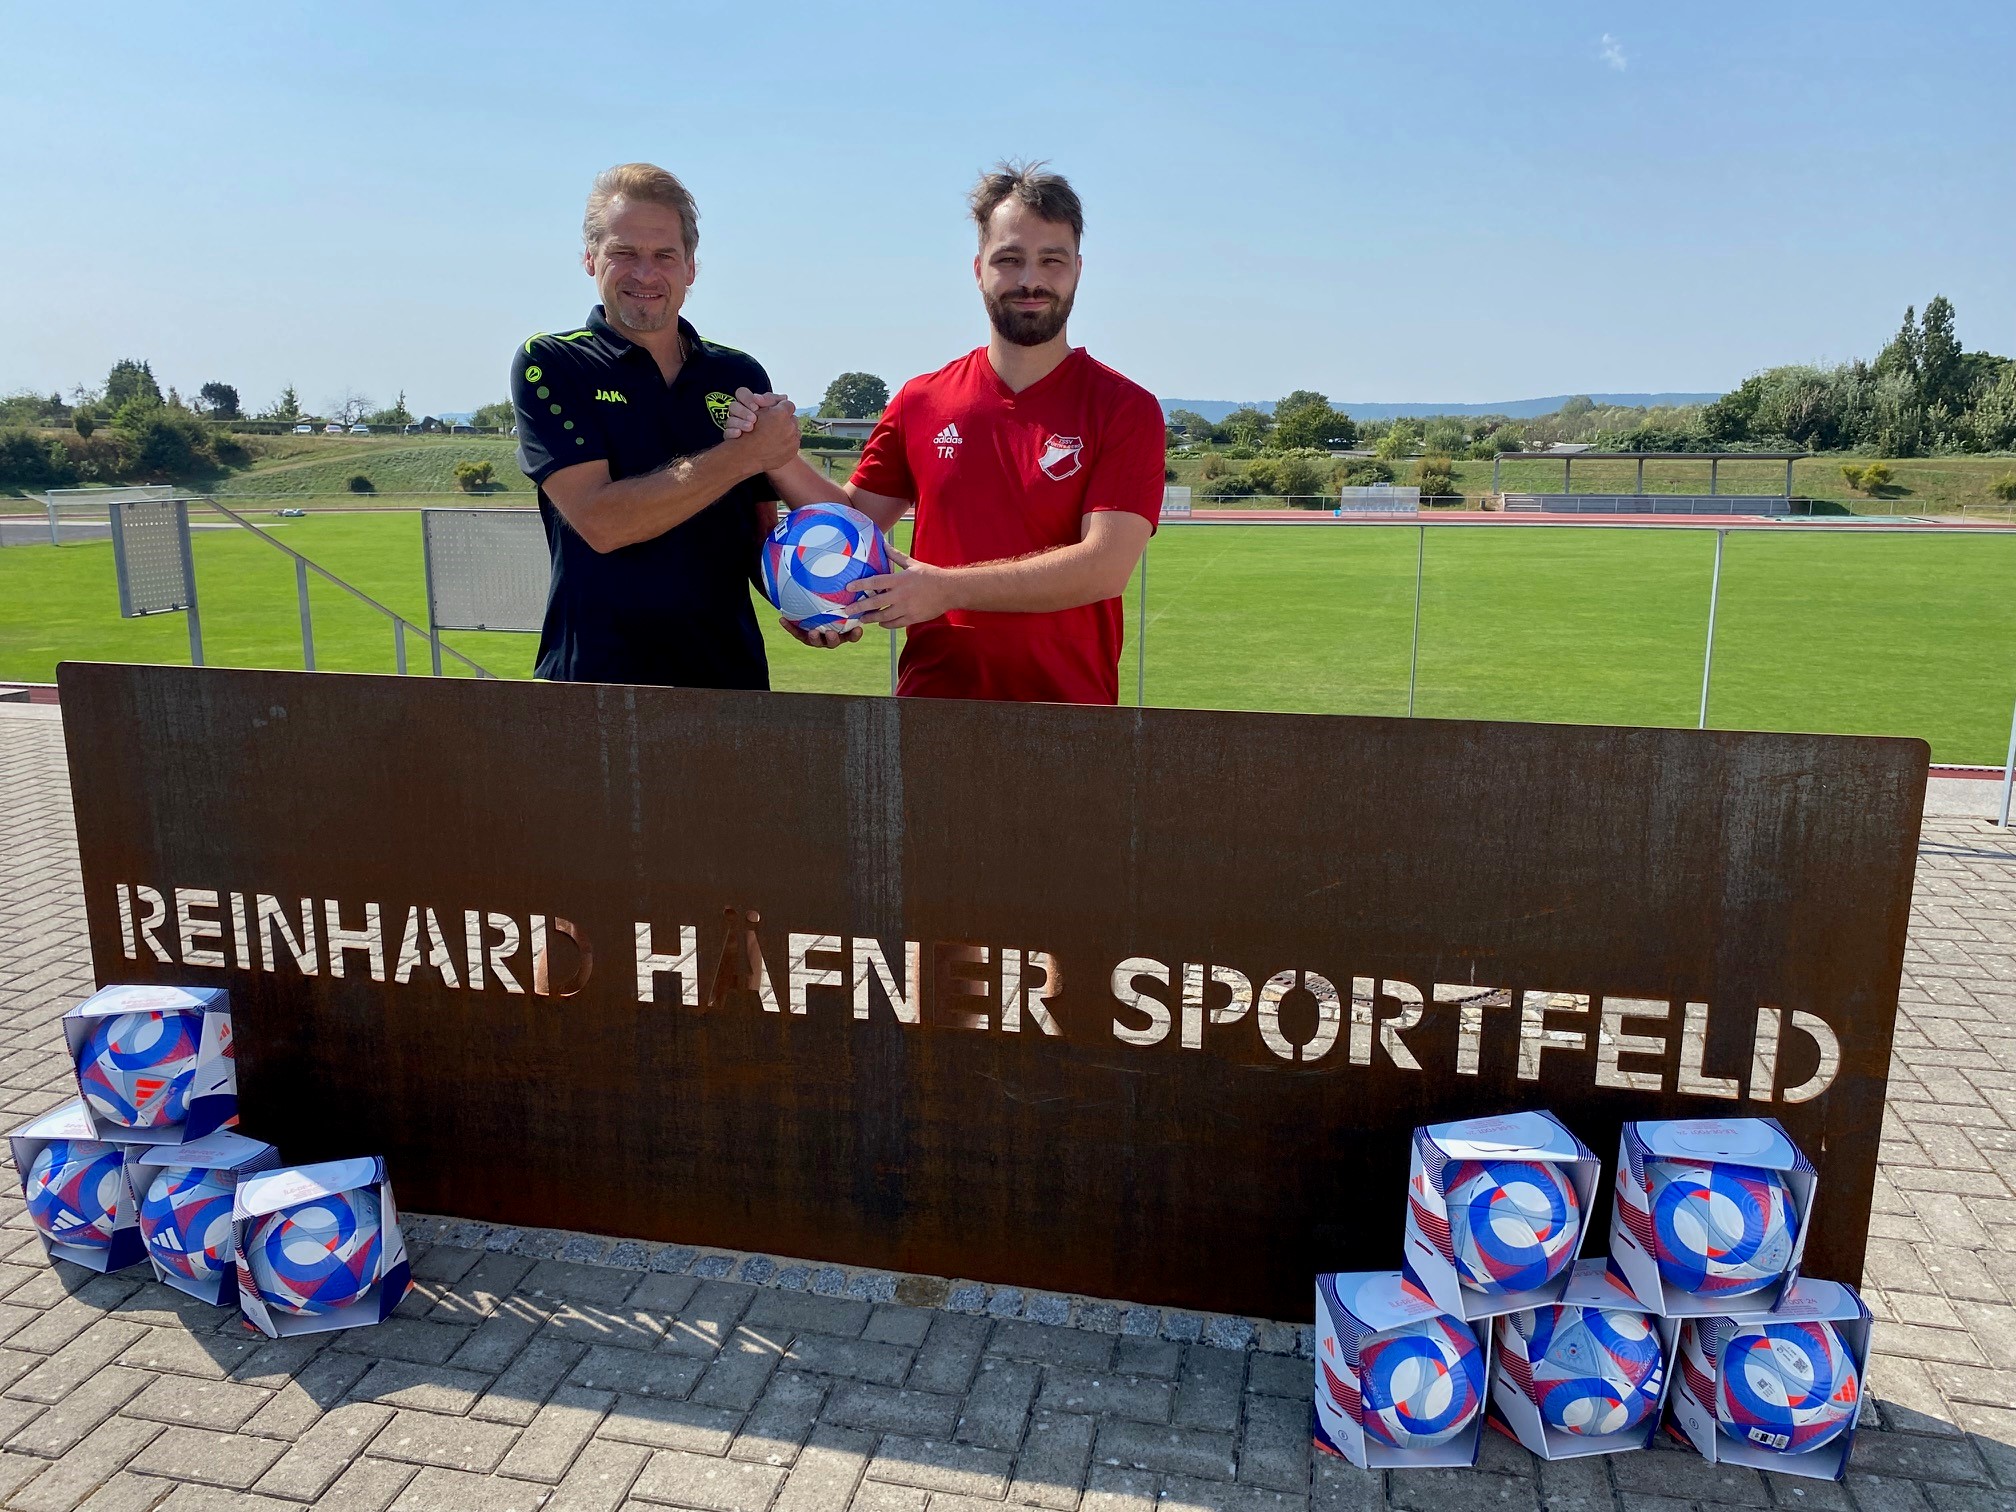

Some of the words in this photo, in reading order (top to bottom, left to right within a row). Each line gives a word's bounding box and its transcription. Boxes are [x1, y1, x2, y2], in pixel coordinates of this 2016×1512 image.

[933, 435, 963, 445] adidas
[937, 446, 955, 459] TR
[116, 883, 593, 997] REINHARD
[635, 905, 1064, 1036] HÄFNER
[1110, 956, 1841, 1103] SPORTFELD
